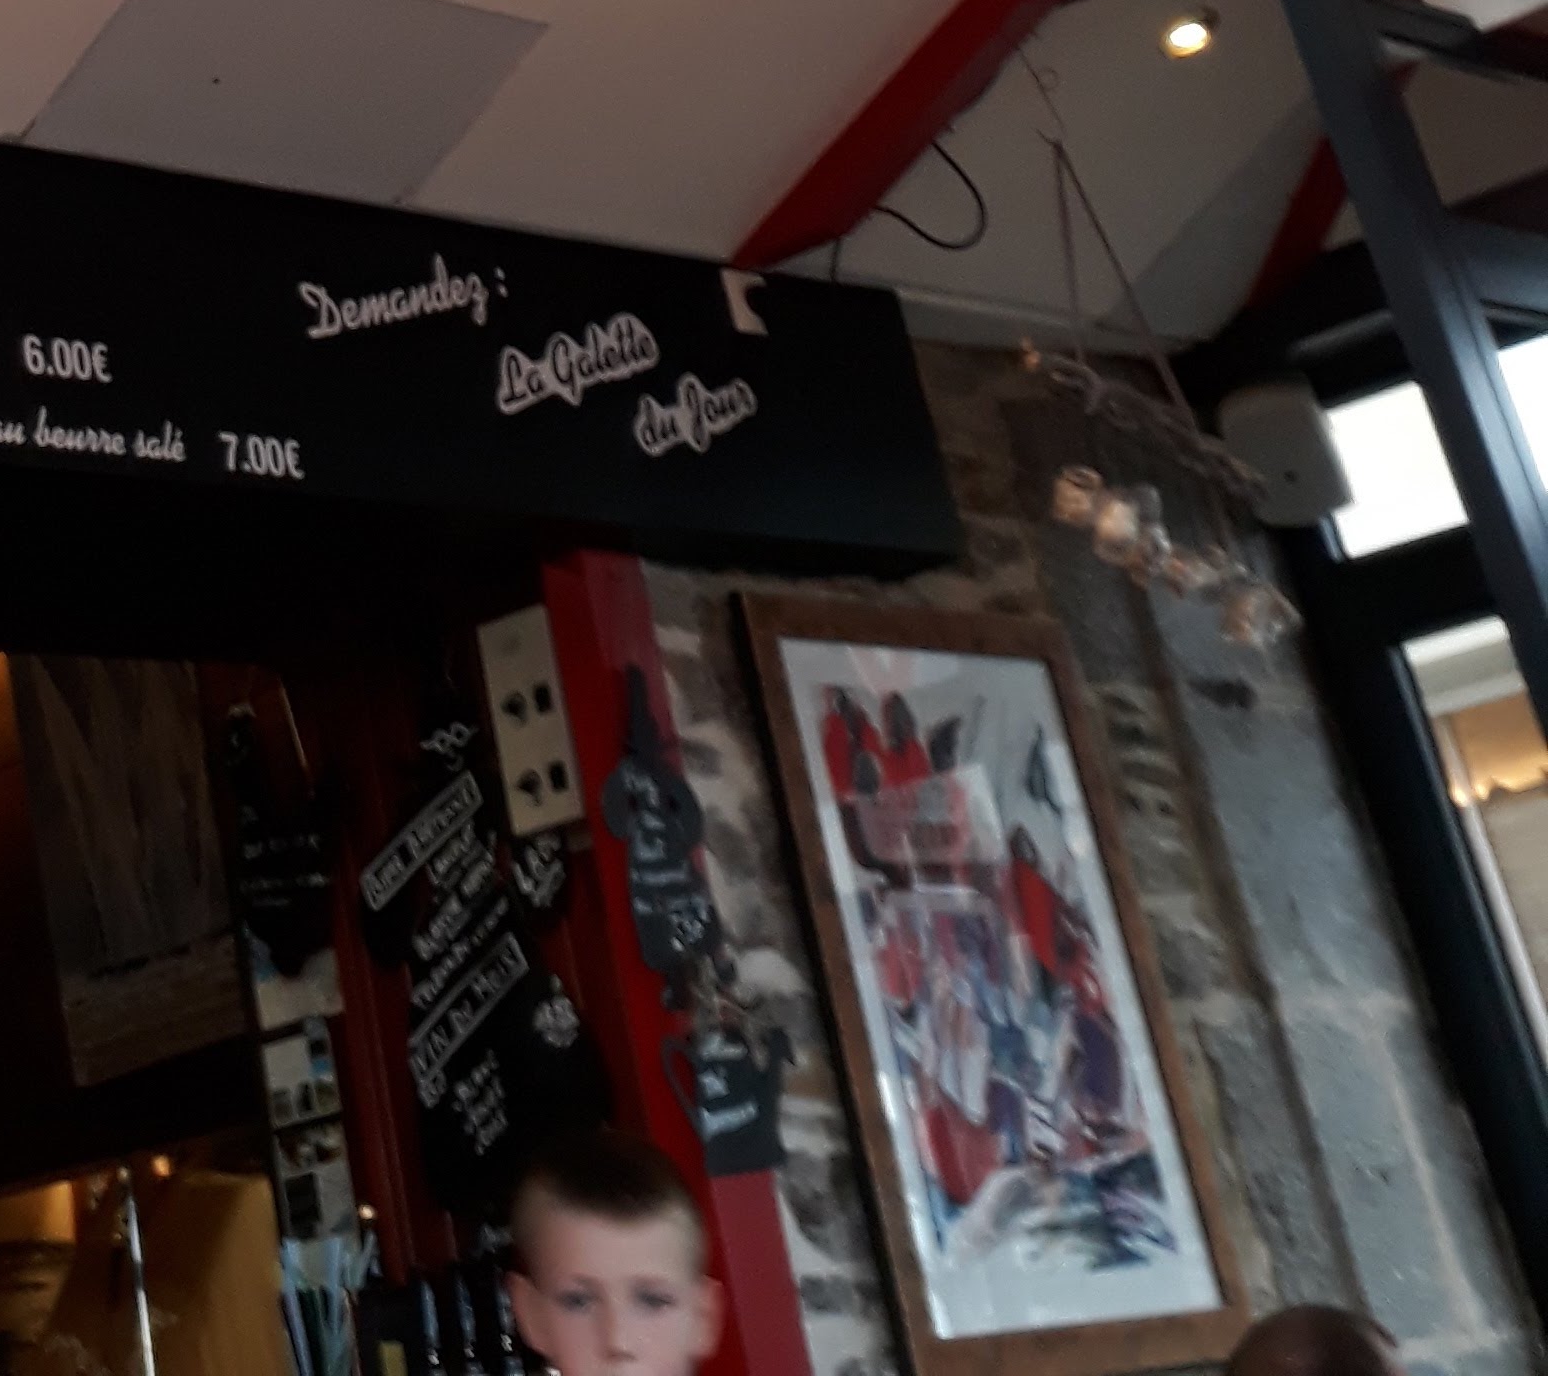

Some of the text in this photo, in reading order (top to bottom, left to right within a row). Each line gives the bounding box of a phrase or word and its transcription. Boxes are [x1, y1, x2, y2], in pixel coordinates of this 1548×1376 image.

[297, 252, 489, 340] Demandez
[22, 334, 113, 384] 6.00€
[502, 317, 657, 406] La Galette
[34, 405, 127, 456] beurre
[132, 419, 187, 463] salé
[218, 430, 305, 480] 7.00€
[640, 376, 756, 450] du Jour
